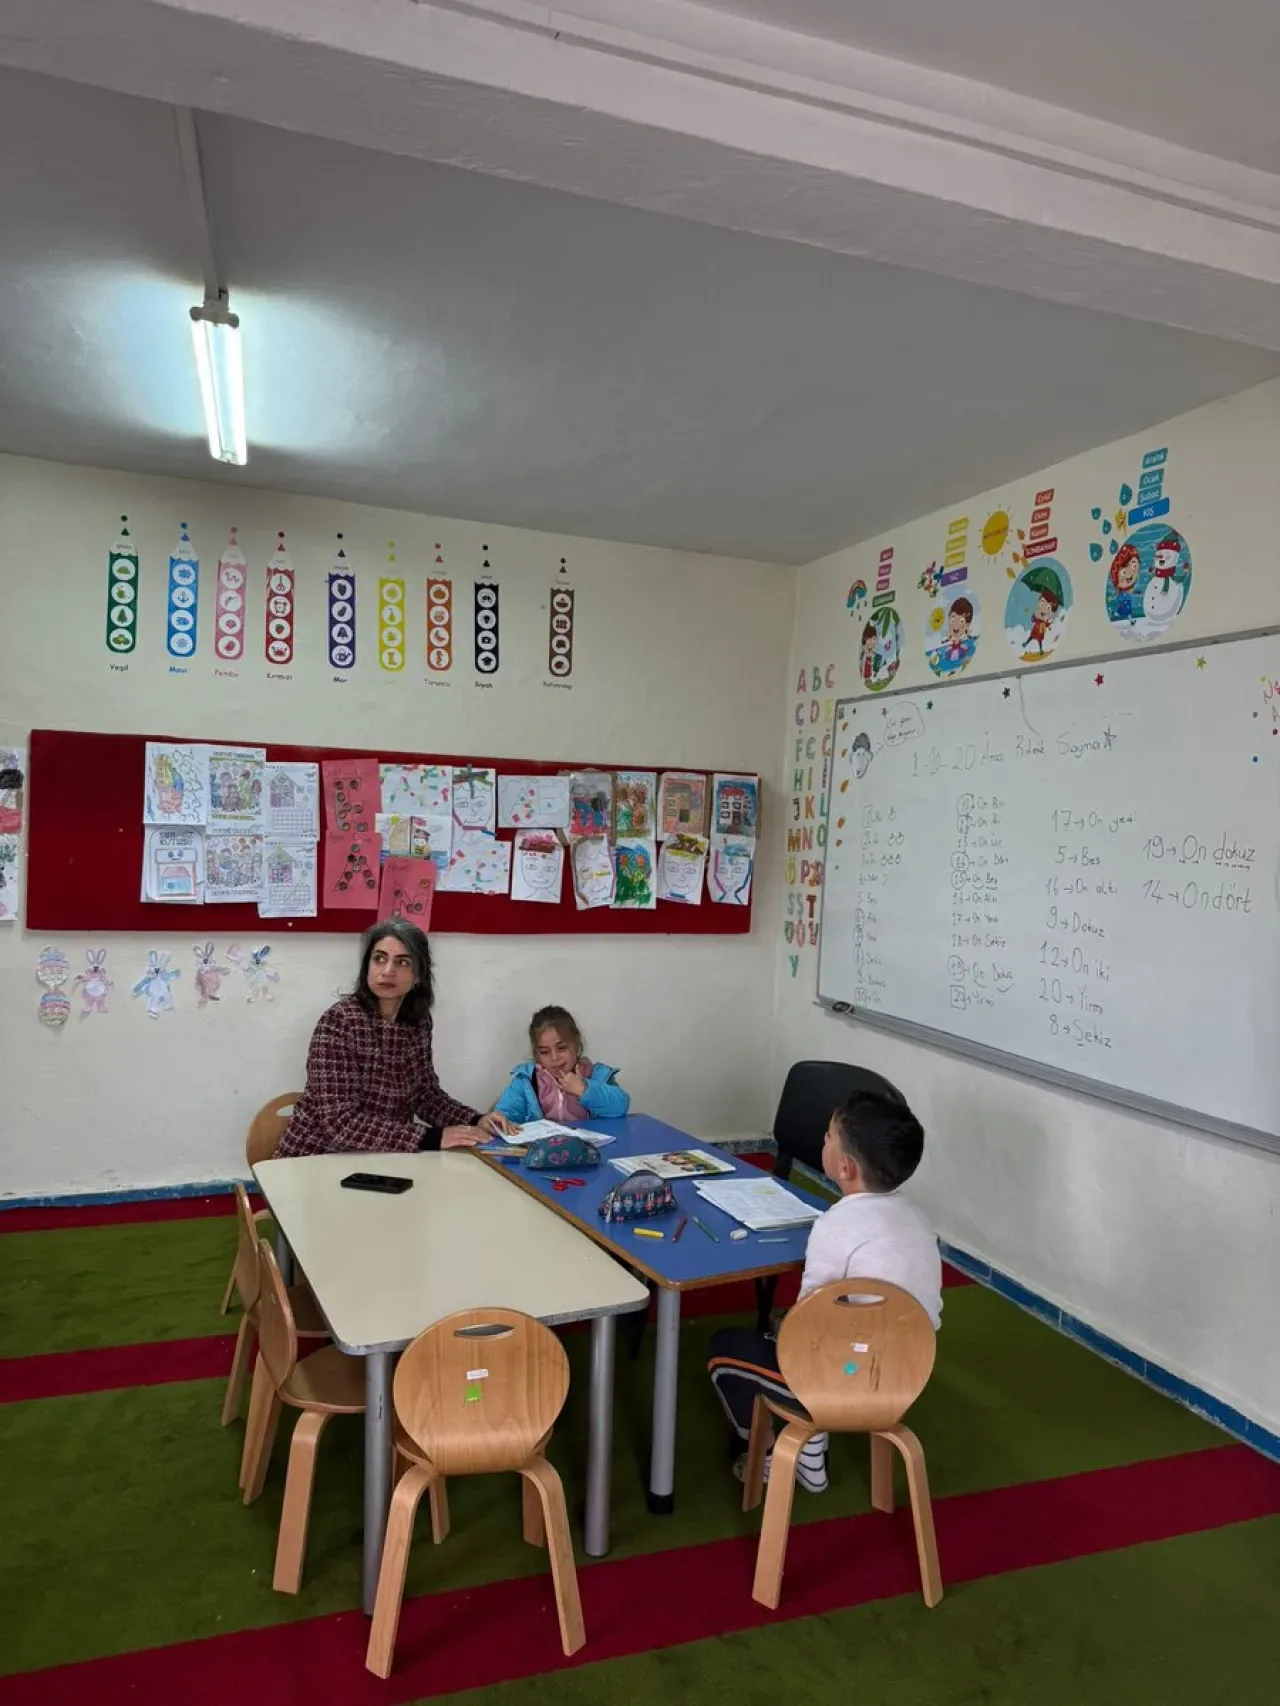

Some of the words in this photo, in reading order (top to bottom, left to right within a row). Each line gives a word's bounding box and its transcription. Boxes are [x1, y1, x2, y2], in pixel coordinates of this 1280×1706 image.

[168, 666, 187, 674] Mavi
[1056, 730, 1101, 759] Sayma
[1051, 809, 1073, 834] 17
[1088, 811, 1103, 828] On
[1054, 845, 1068, 864] 5
[1142, 835, 1164, 860] 19
[1182, 834, 1207, 860] On
[1213, 830, 1256, 862] dokuz
[1045, 877, 1059, 895] 16
[1142, 879, 1164, 904] 14
[1046, 906, 1058, 929] 9
[1072, 911, 1105, 938] Dokuz
[1040, 940, 1059, 967] 12
[1072, 946, 1089, 975] On
[1038, 977, 1062, 1004] 20
[1049, 1013, 1059, 1036] 8
